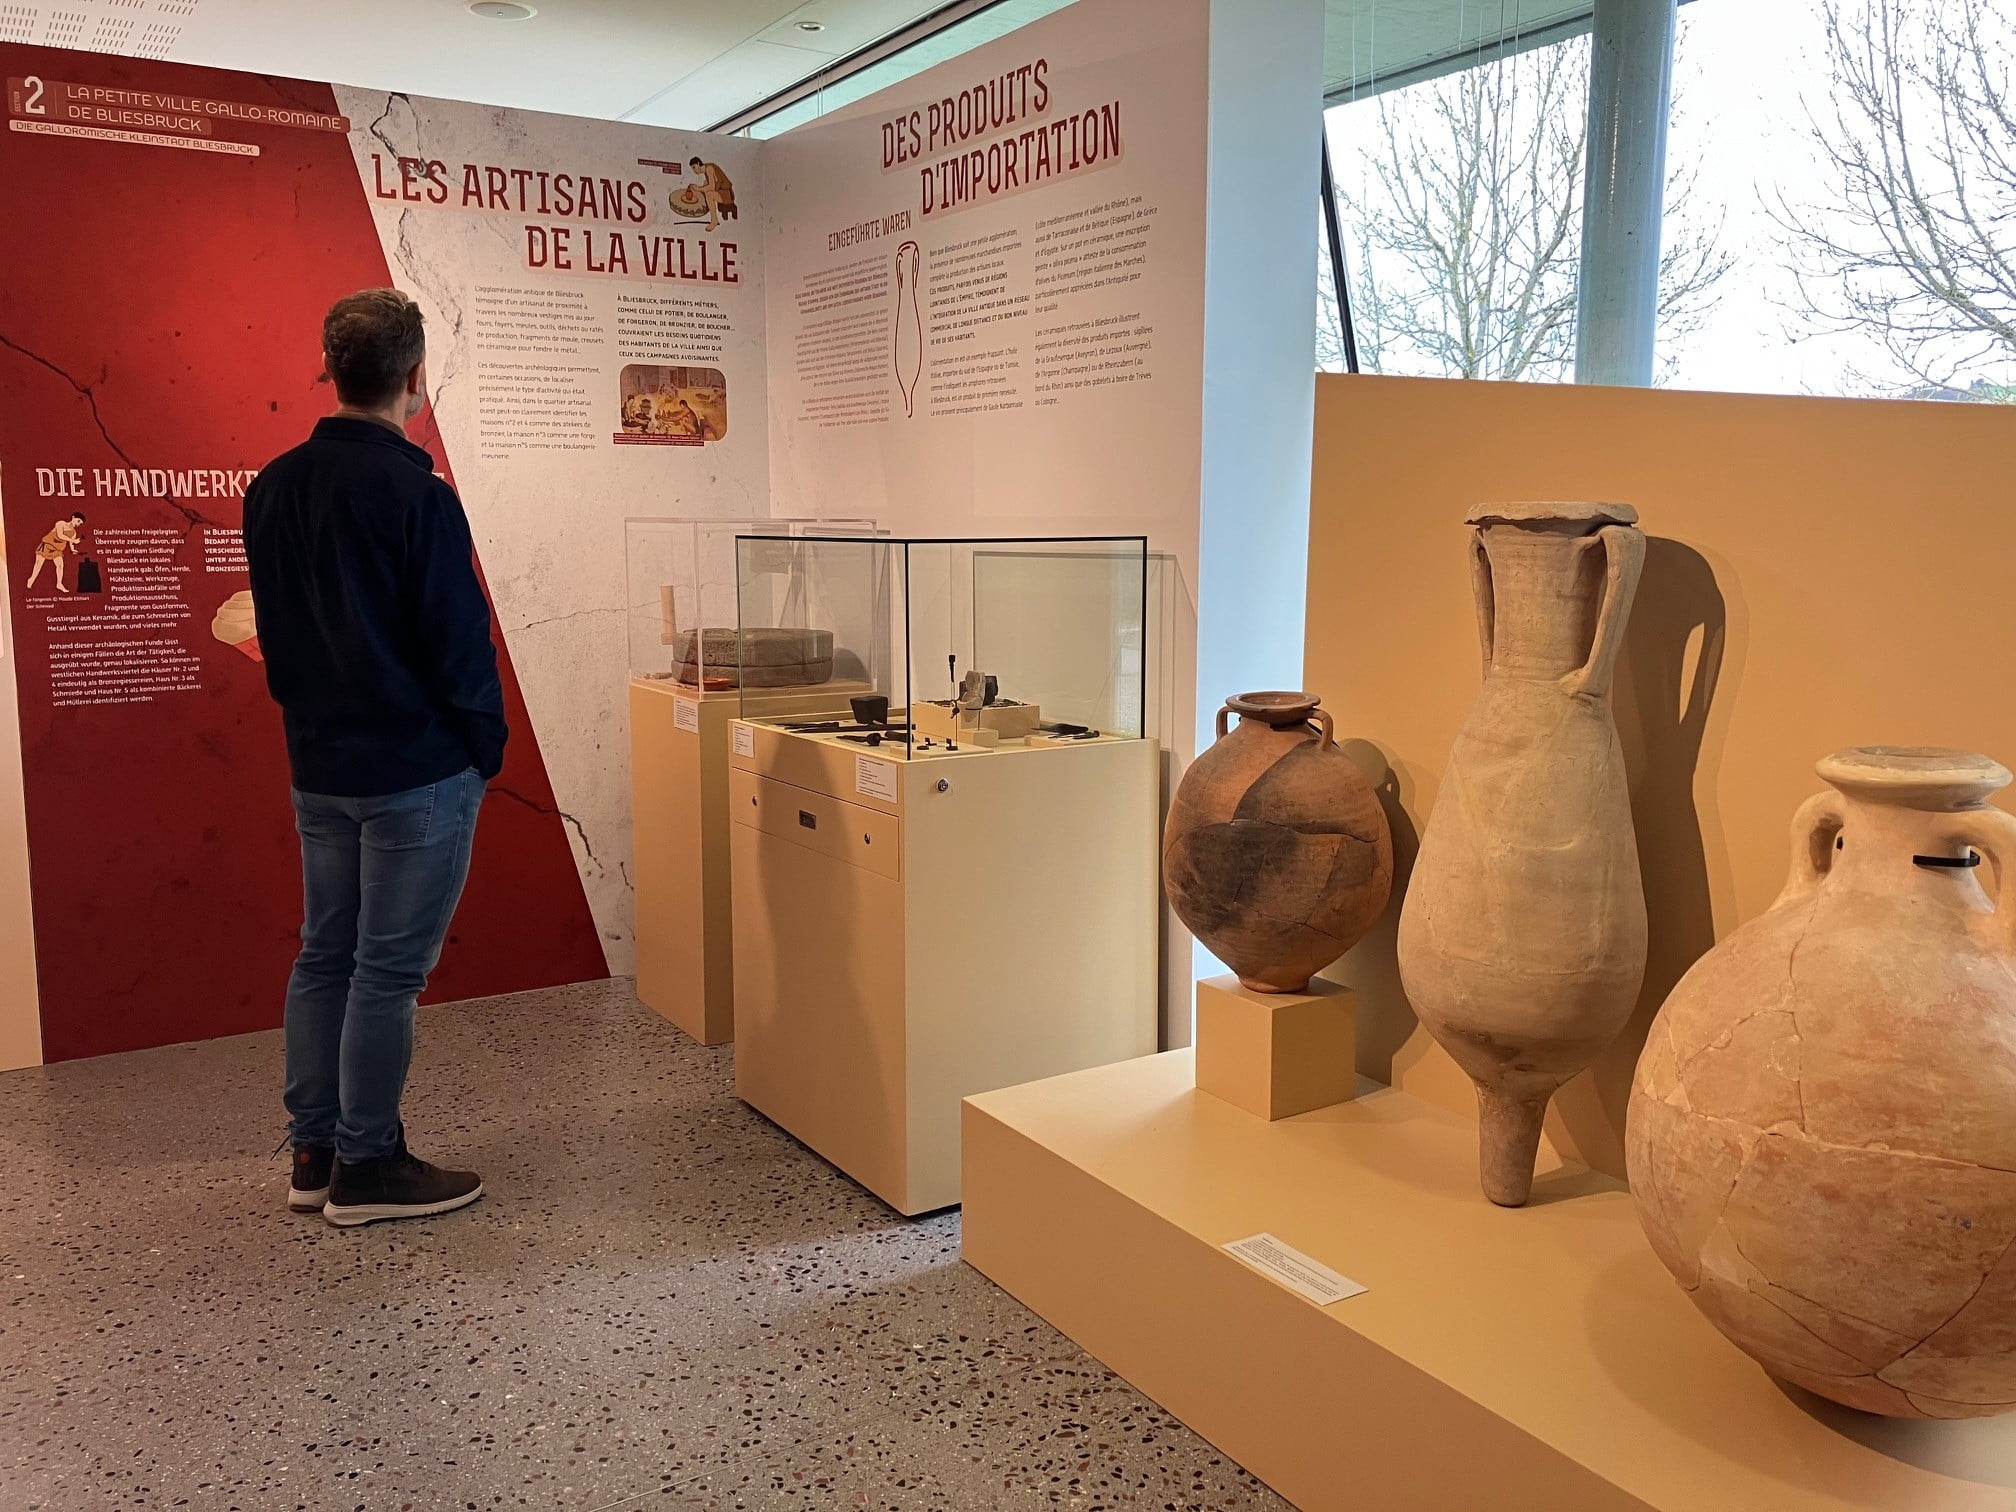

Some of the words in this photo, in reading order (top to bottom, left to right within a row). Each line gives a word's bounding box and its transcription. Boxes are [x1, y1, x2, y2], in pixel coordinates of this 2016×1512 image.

[25, 76, 45, 114] 2
[68, 86, 89, 99] LA
[95, 89, 151, 106] PETITE
[156, 96, 201, 112] VILLE
[206, 102, 341, 129] GALLO-ROMAINE
[882, 110, 921, 168] DES
[928, 59, 1048, 152] PRODUITS
[16, 122, 32, 130] DIE
[130, 135, 190, 147] KLEINSTADT
[193, 140, 253, 153] BLIESBRUCK
[69, 106, 91, 119] DE
[97, 109, 201, 131] BLIESBRUCK
[921, 102, 1119, 215] D'IMPORTATION
[372, 154, 447, 204] LES
[463, 164, 646, 222] ARTISANS
[828, 218, 879, 251] EINGEFÜHRTE
[882, 210, 911, 238] WAREN
[525, 226, 571, 268] DE
[584, 231, 628, 273] LA
[638, 234, 739, 282] VILLE
[623, 296, 659, 304] BLIESBRUCK,
[695, 301, 720, 309] MÉTIERS,
[36, 468, 85, 496] DIE
